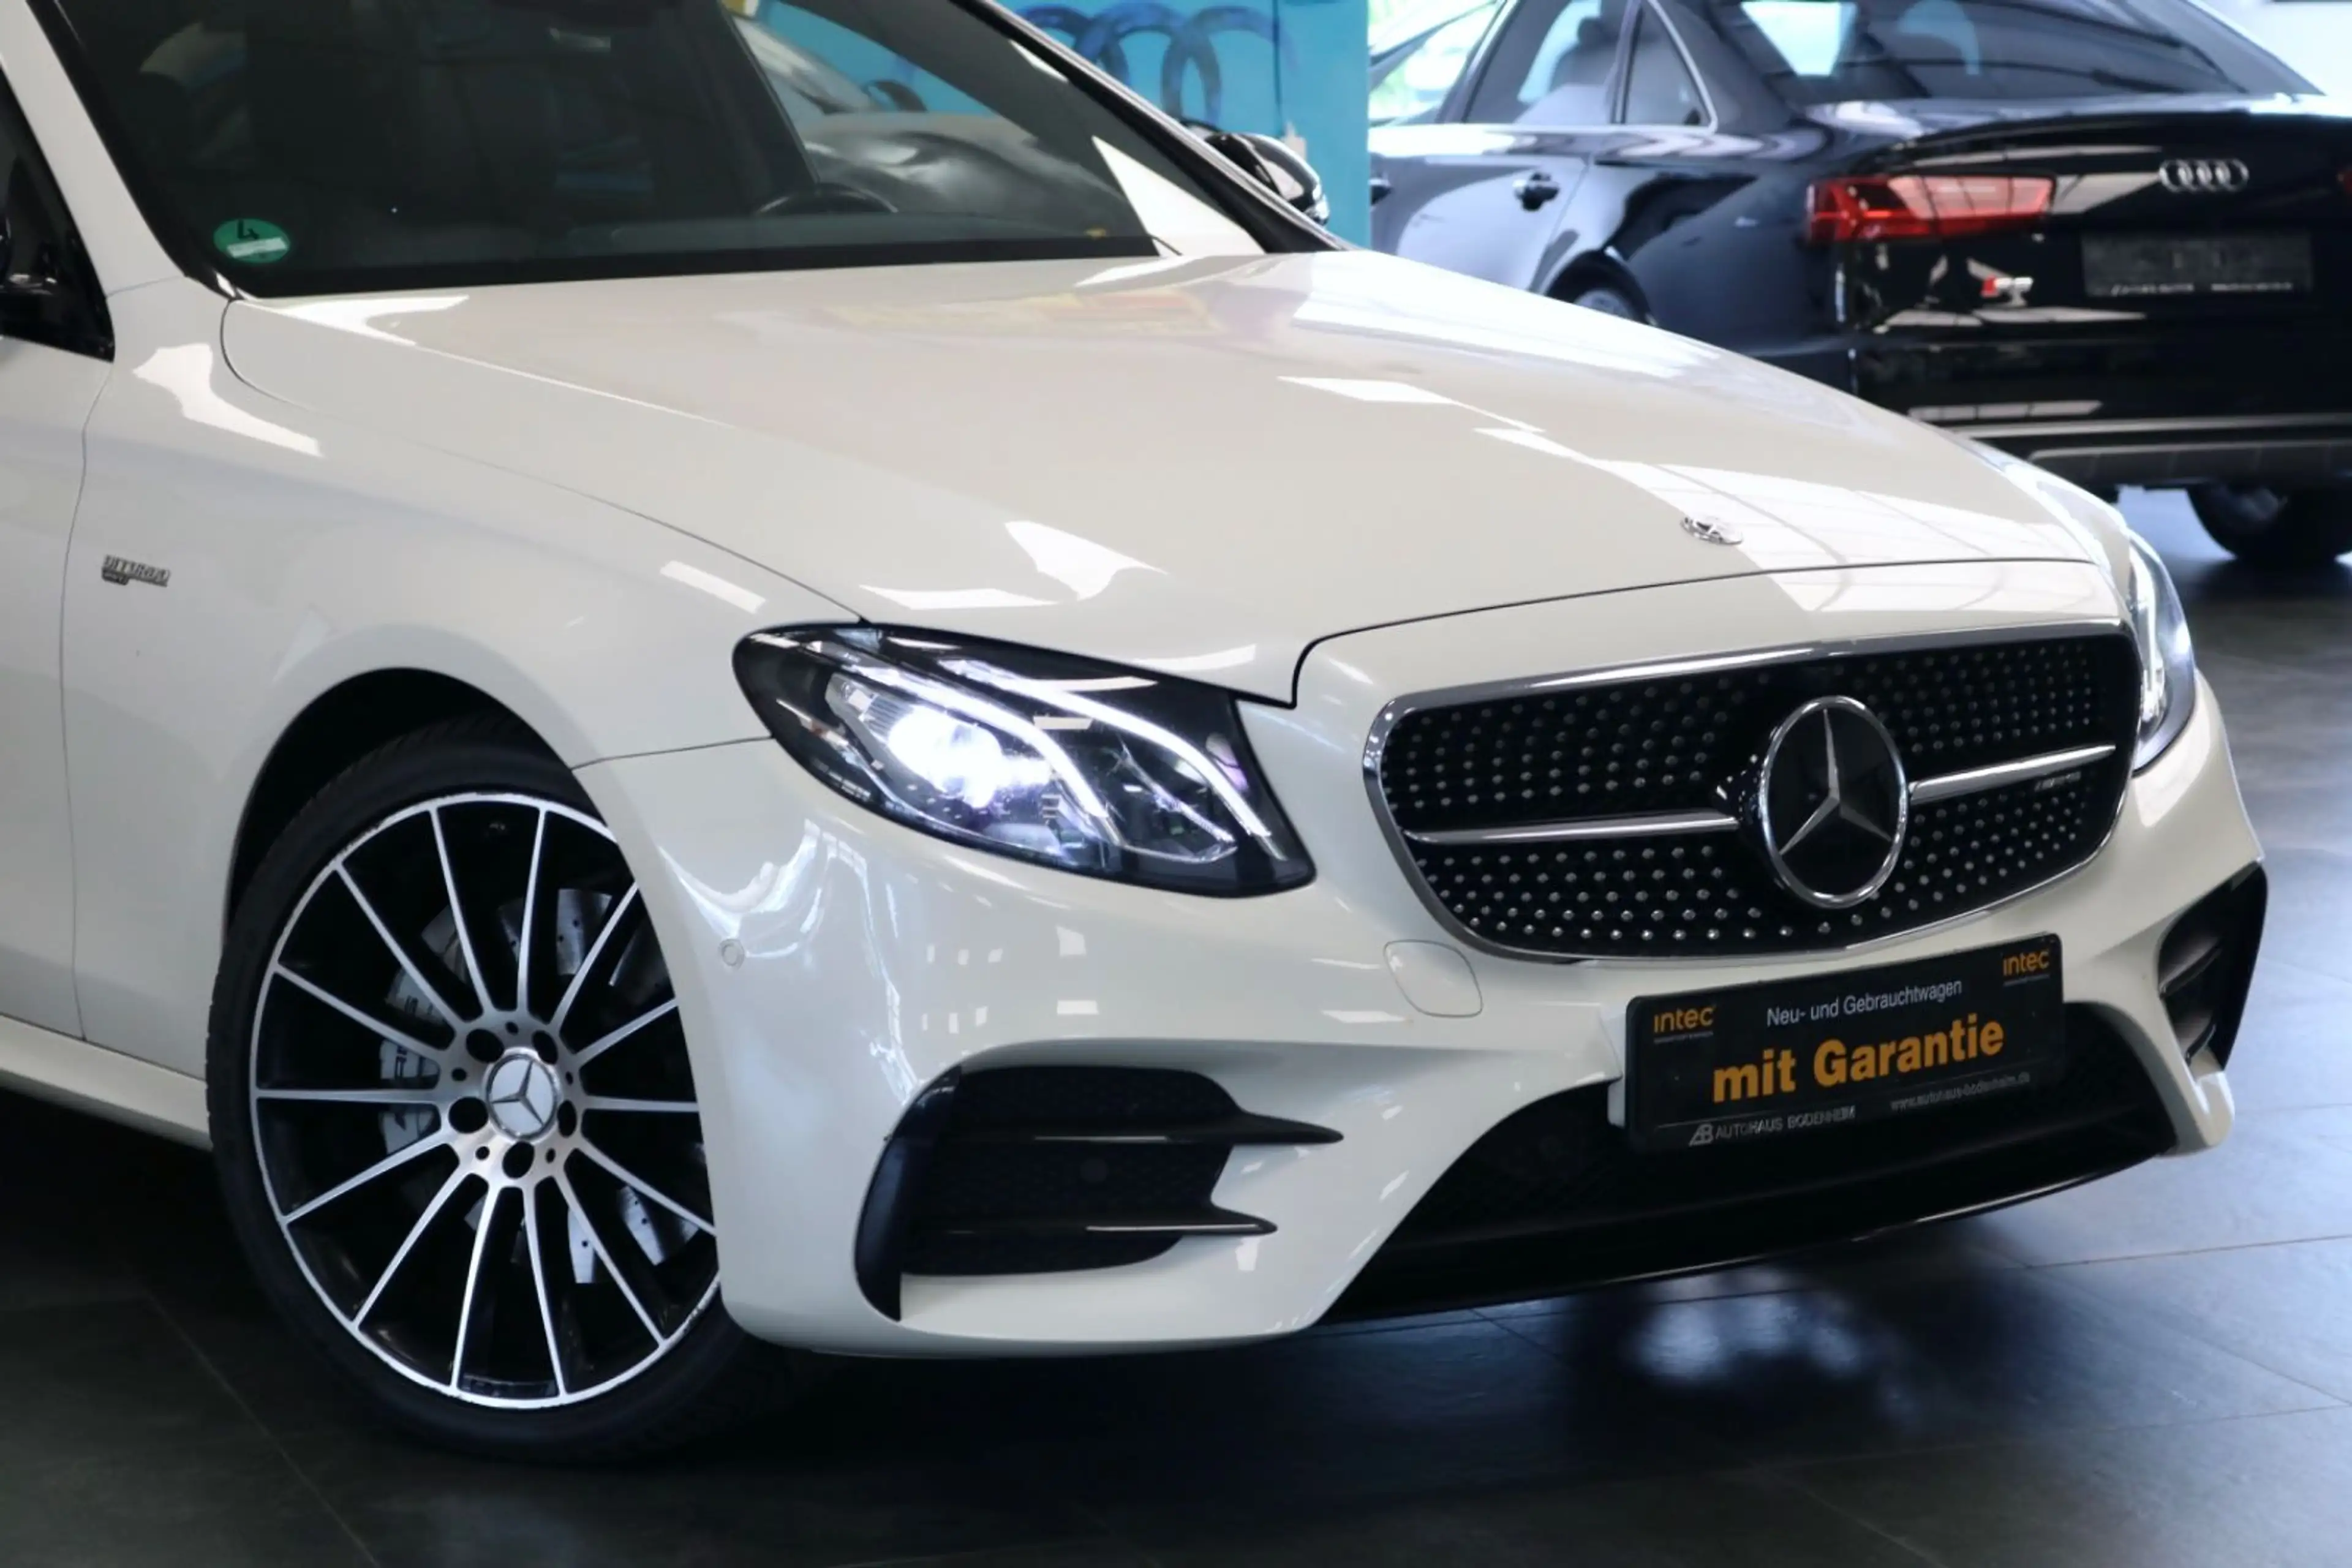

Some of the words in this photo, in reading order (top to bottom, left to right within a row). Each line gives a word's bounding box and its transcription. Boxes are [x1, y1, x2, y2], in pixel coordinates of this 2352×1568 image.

[238, 219, 260, 240] 4
[2003, 951, 2050, 976] intec
[1766, 1008, 1806, 1028] Neu-
[1811, 999, 1839, 1020] und
[1843, 979, 1962, 1015] Gebrauchtwagen
[1654, 1006, 1714, 1033] intec
[1713, 1049, 1796, 1103] mit
[1813, 1013, 2005, 1088] Garantie
[1715, 1117, 1784, 1140] AUTOHAUS
